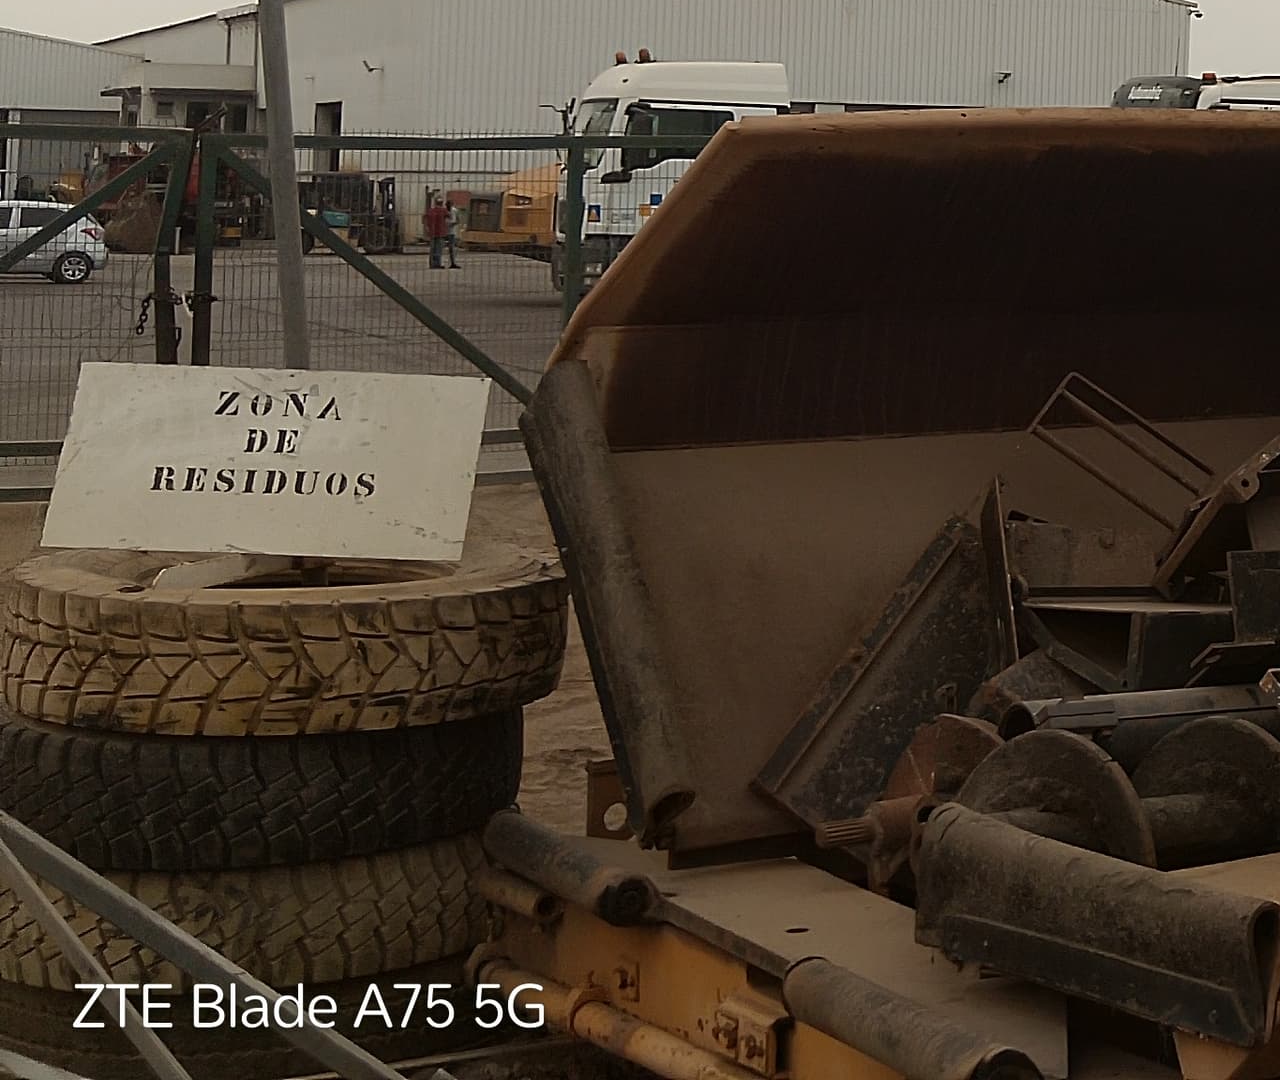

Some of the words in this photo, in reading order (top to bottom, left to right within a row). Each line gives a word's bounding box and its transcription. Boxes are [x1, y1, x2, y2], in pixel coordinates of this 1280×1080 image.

[214, 391, 342, 421] ZONA
[243, 428, 299, 454] DE
[150, 466, 376, 497] RESIDUOS
